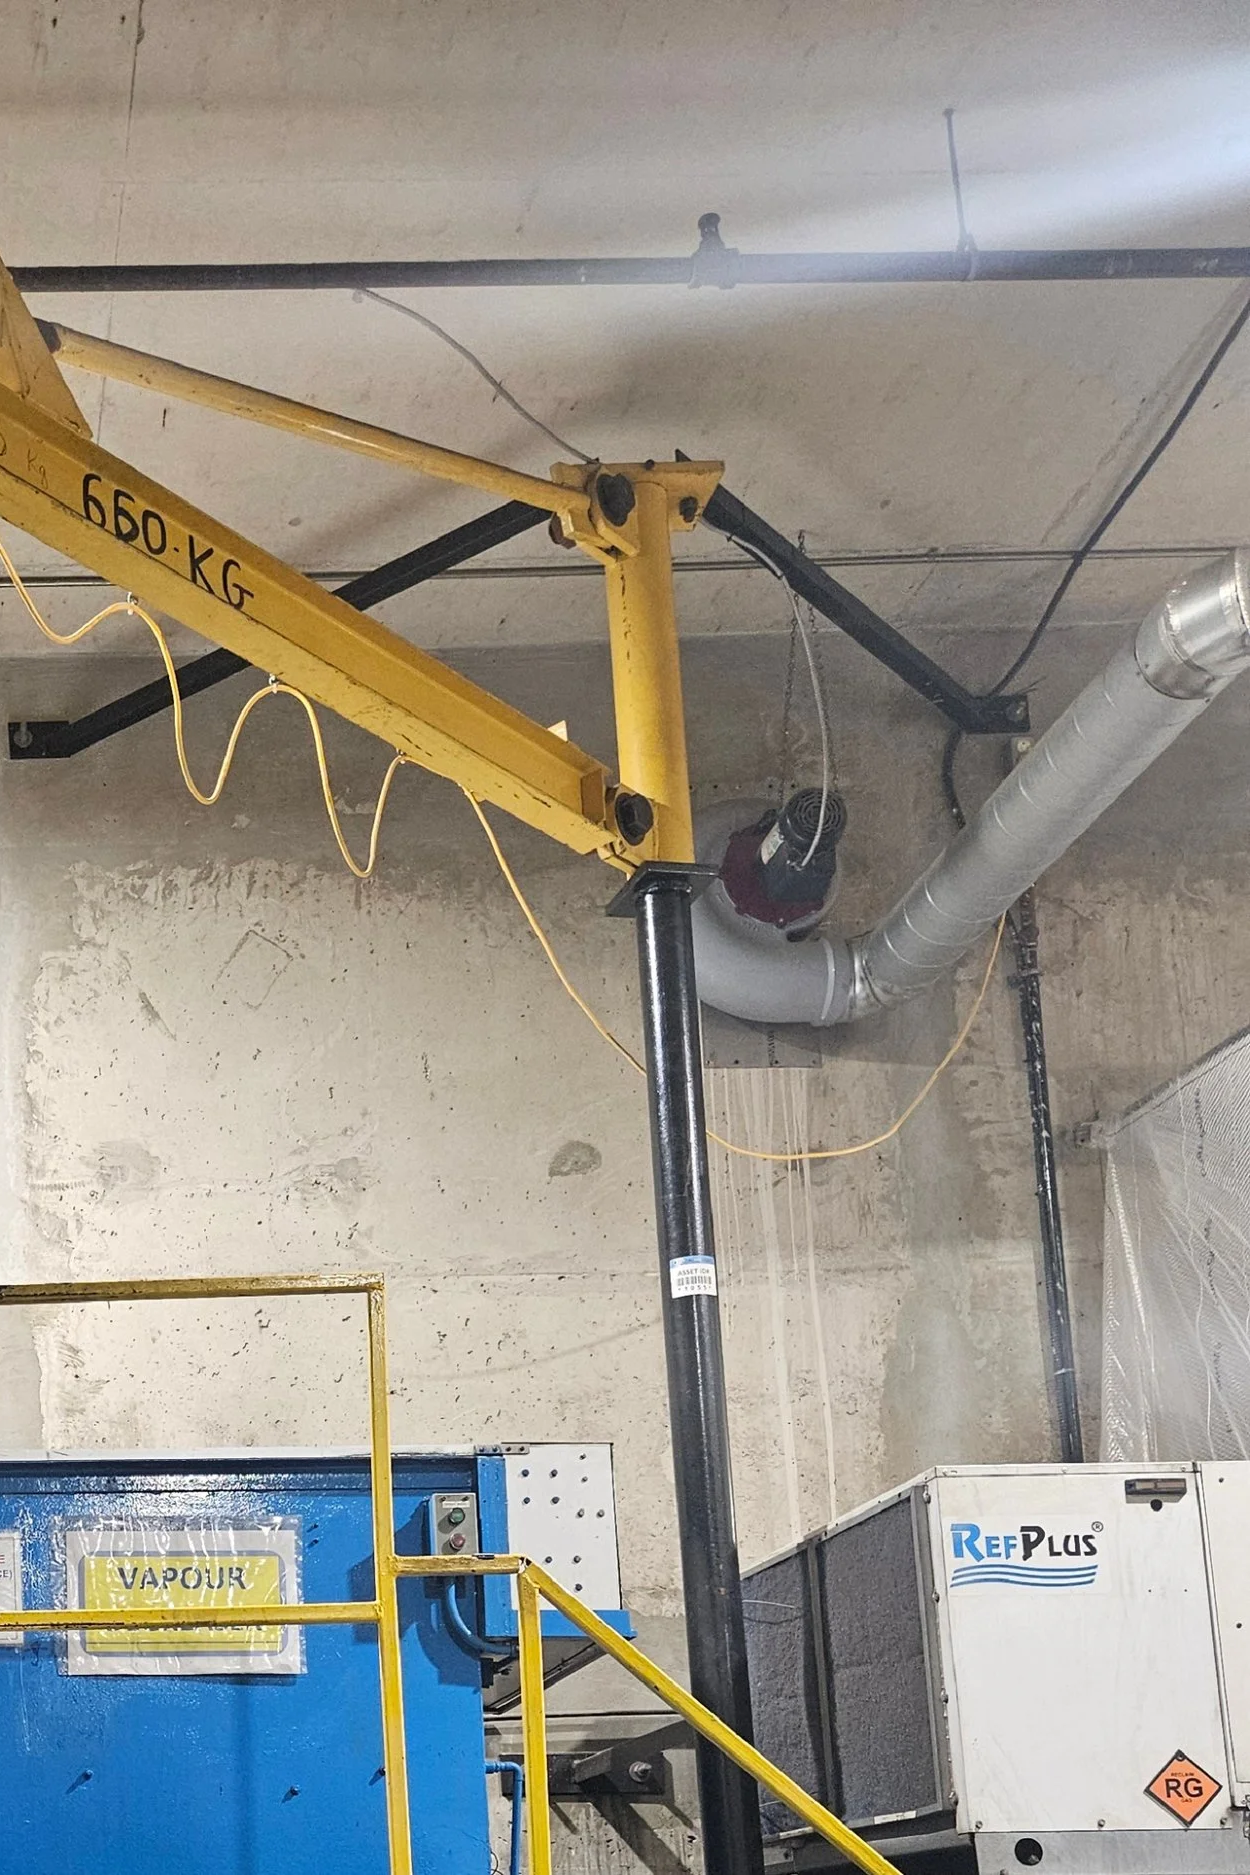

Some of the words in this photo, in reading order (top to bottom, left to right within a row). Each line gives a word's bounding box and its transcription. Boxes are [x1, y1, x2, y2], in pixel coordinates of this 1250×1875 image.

[678, 1268, 698, 1276] ASSET
[118, 1567, 247, 1590] VAPOUR
[1165, 1778, 1203, 1798] RG
